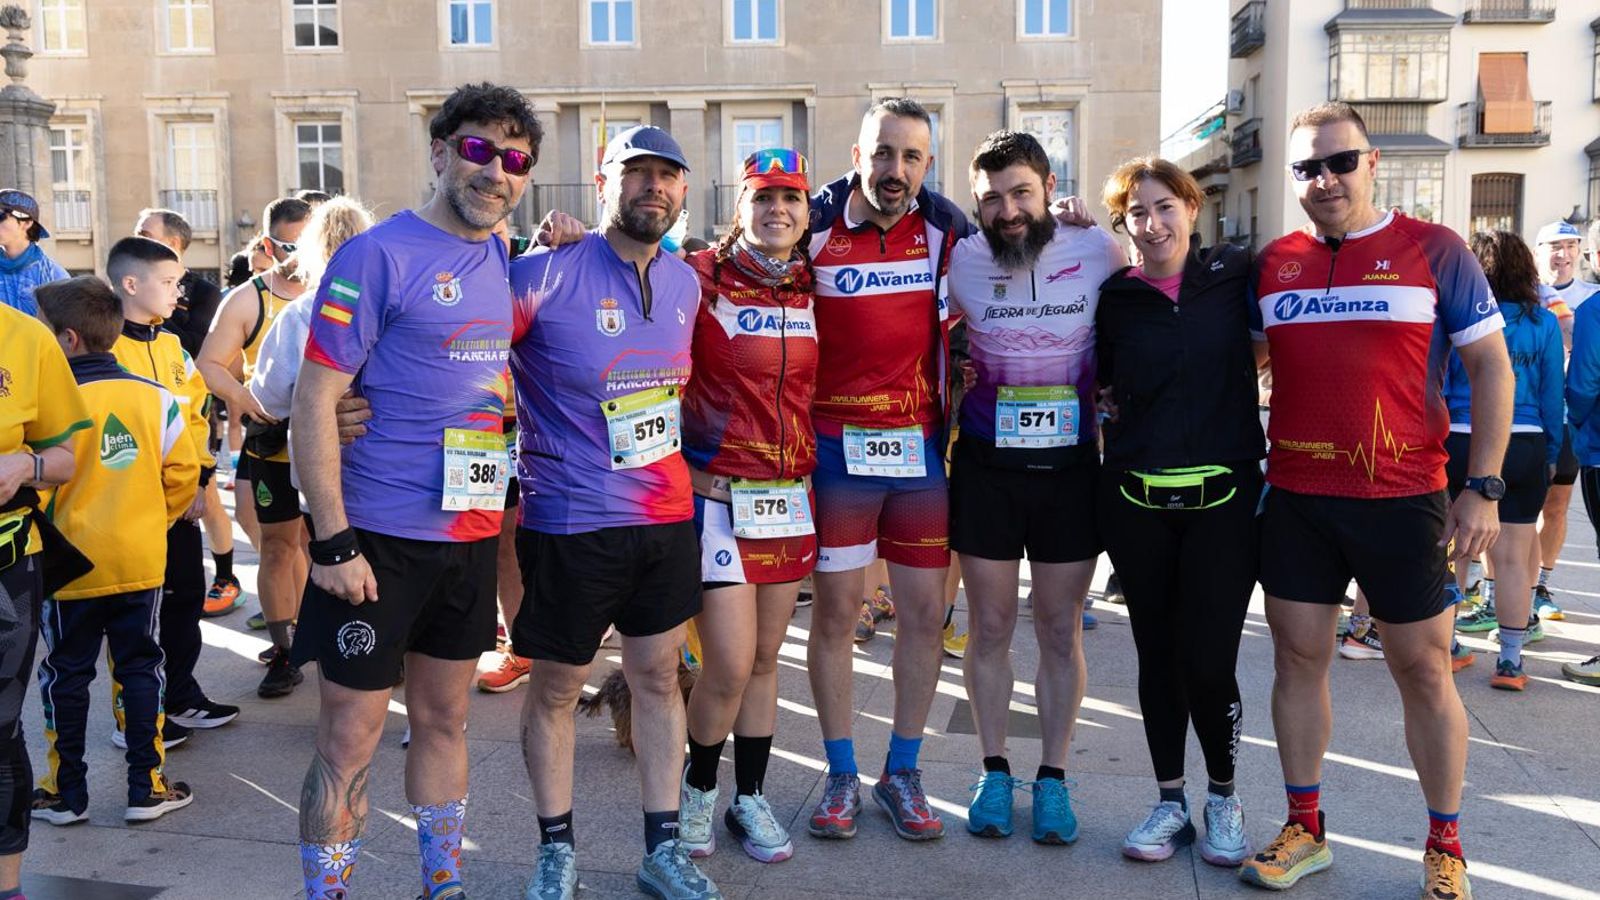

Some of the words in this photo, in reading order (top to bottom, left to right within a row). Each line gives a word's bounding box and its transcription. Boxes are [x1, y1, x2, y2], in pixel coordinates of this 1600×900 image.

[865, 271, 933, 288] Avanza
[1362, 273, 1400, 281] JUANJO
[981, 305, 1024, 322] SIERRA
[1025, 307, 1037, 316] DE
[1036, 303, 1084, 319] SEGURA
[1303, 297, 1389, 315] Avanza
[764, 315, 811, 330] Avanza
[634, 416, 666, 441] 579
[1019, 411, 1055, 428] 571
[100, 431, 133, 457] Jaén
[866, 440, 902, 457] 303
[469, 462, 497, 484] 388
[754, 498, 788, 516] 578
